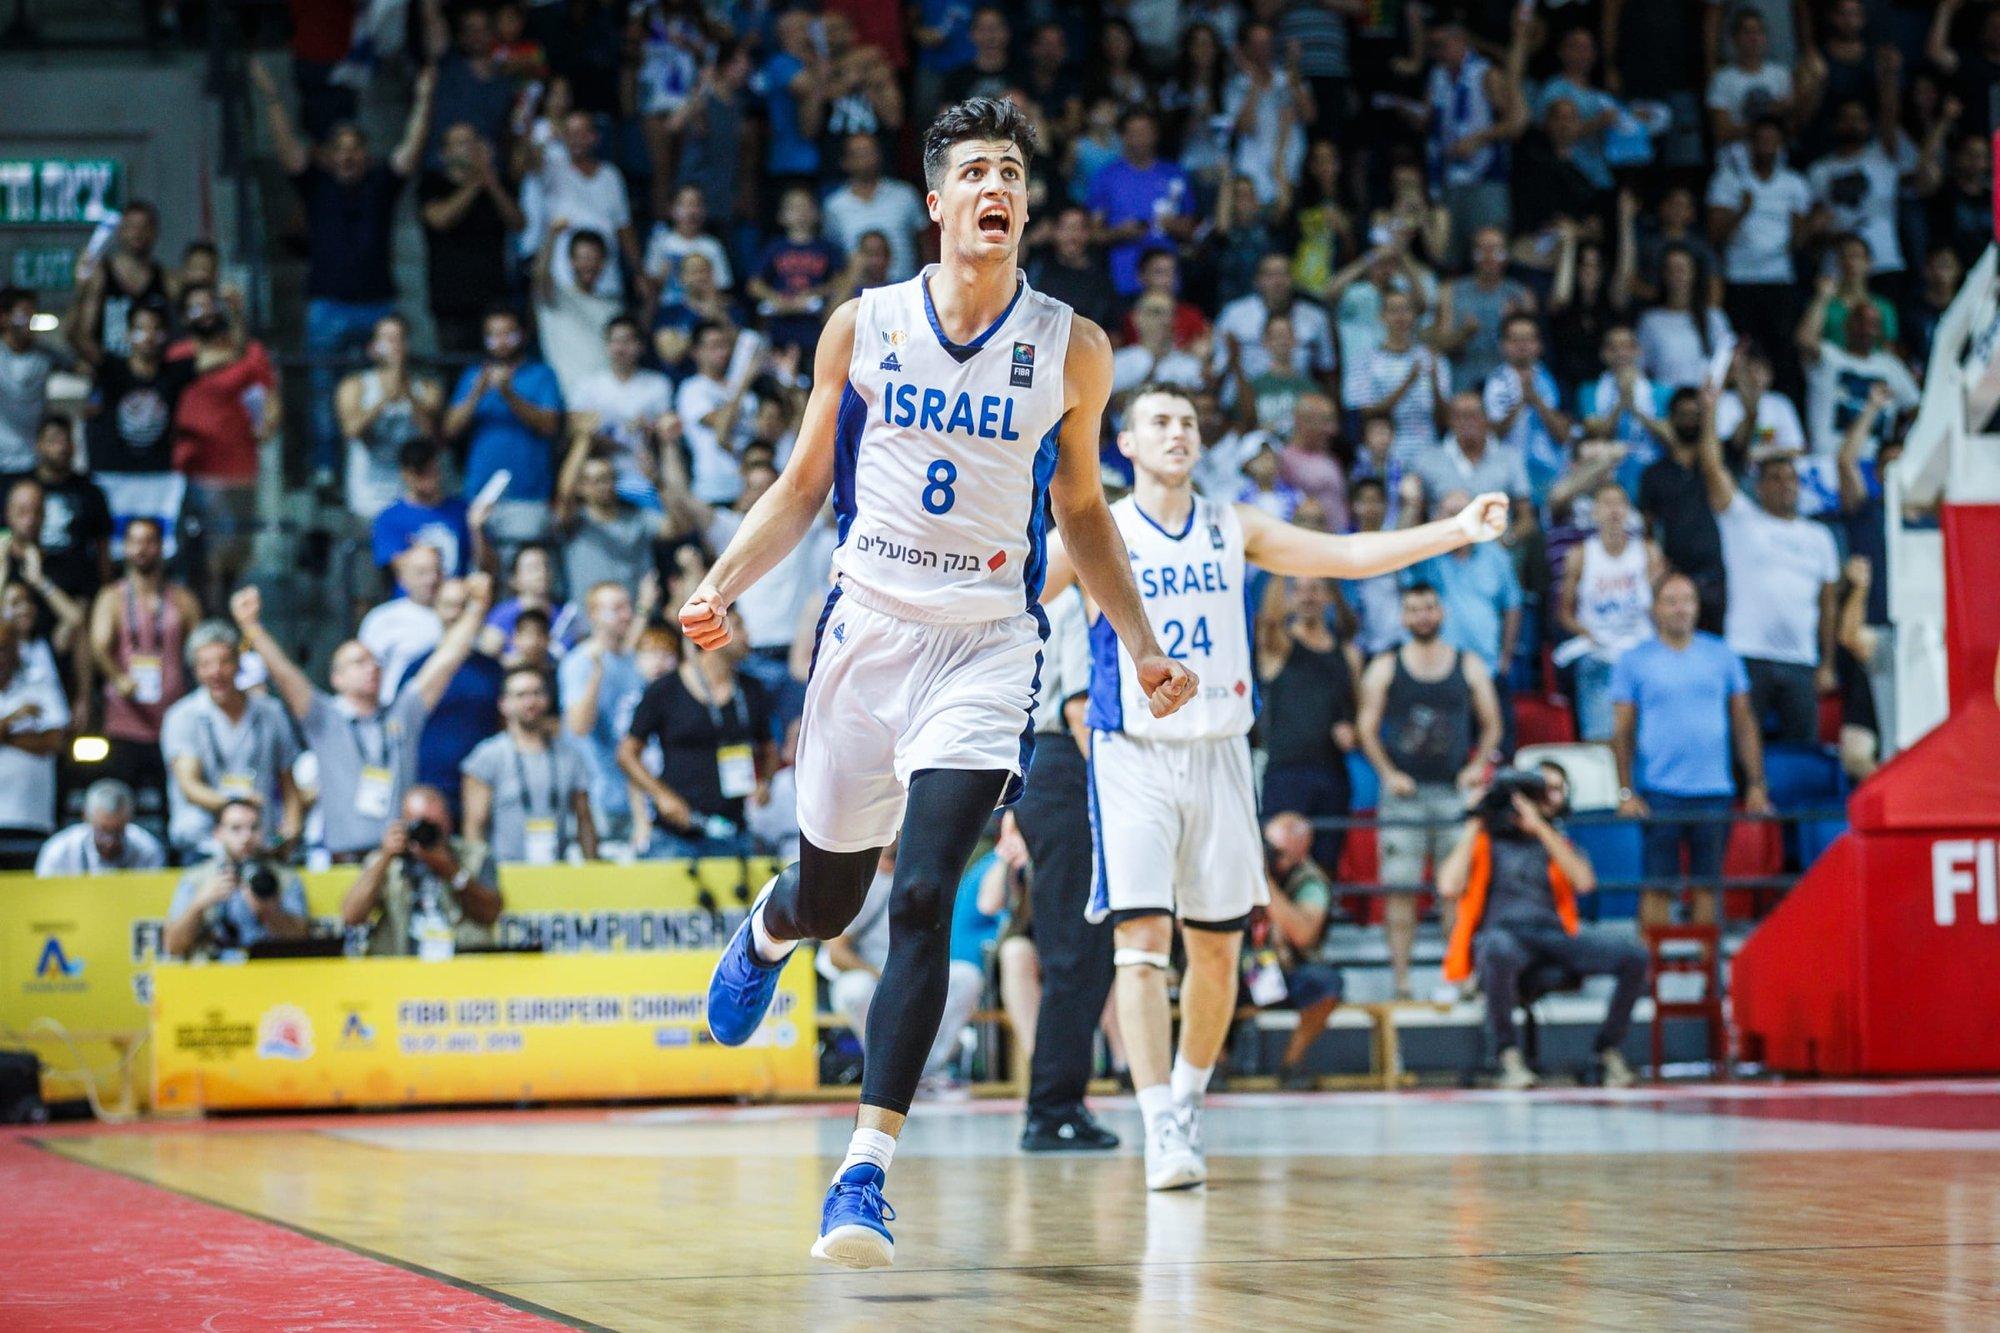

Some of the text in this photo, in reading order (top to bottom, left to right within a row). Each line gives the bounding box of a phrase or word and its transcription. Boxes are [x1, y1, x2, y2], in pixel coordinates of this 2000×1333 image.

[1014, 367, 1030, 377] FIBA
[885, 382, 1019, 441] ISRAEL
[922, 459, 957, 515] 8
[857, 534, 981, 573] בנק הפועלים
[1133, 562, 1228, 598] SRAEL
[1164, 616, 1212, 659] 24
[1932, 840, 2000, 926] FI
[504, 913, 750, 951] CHAMPIONSH
